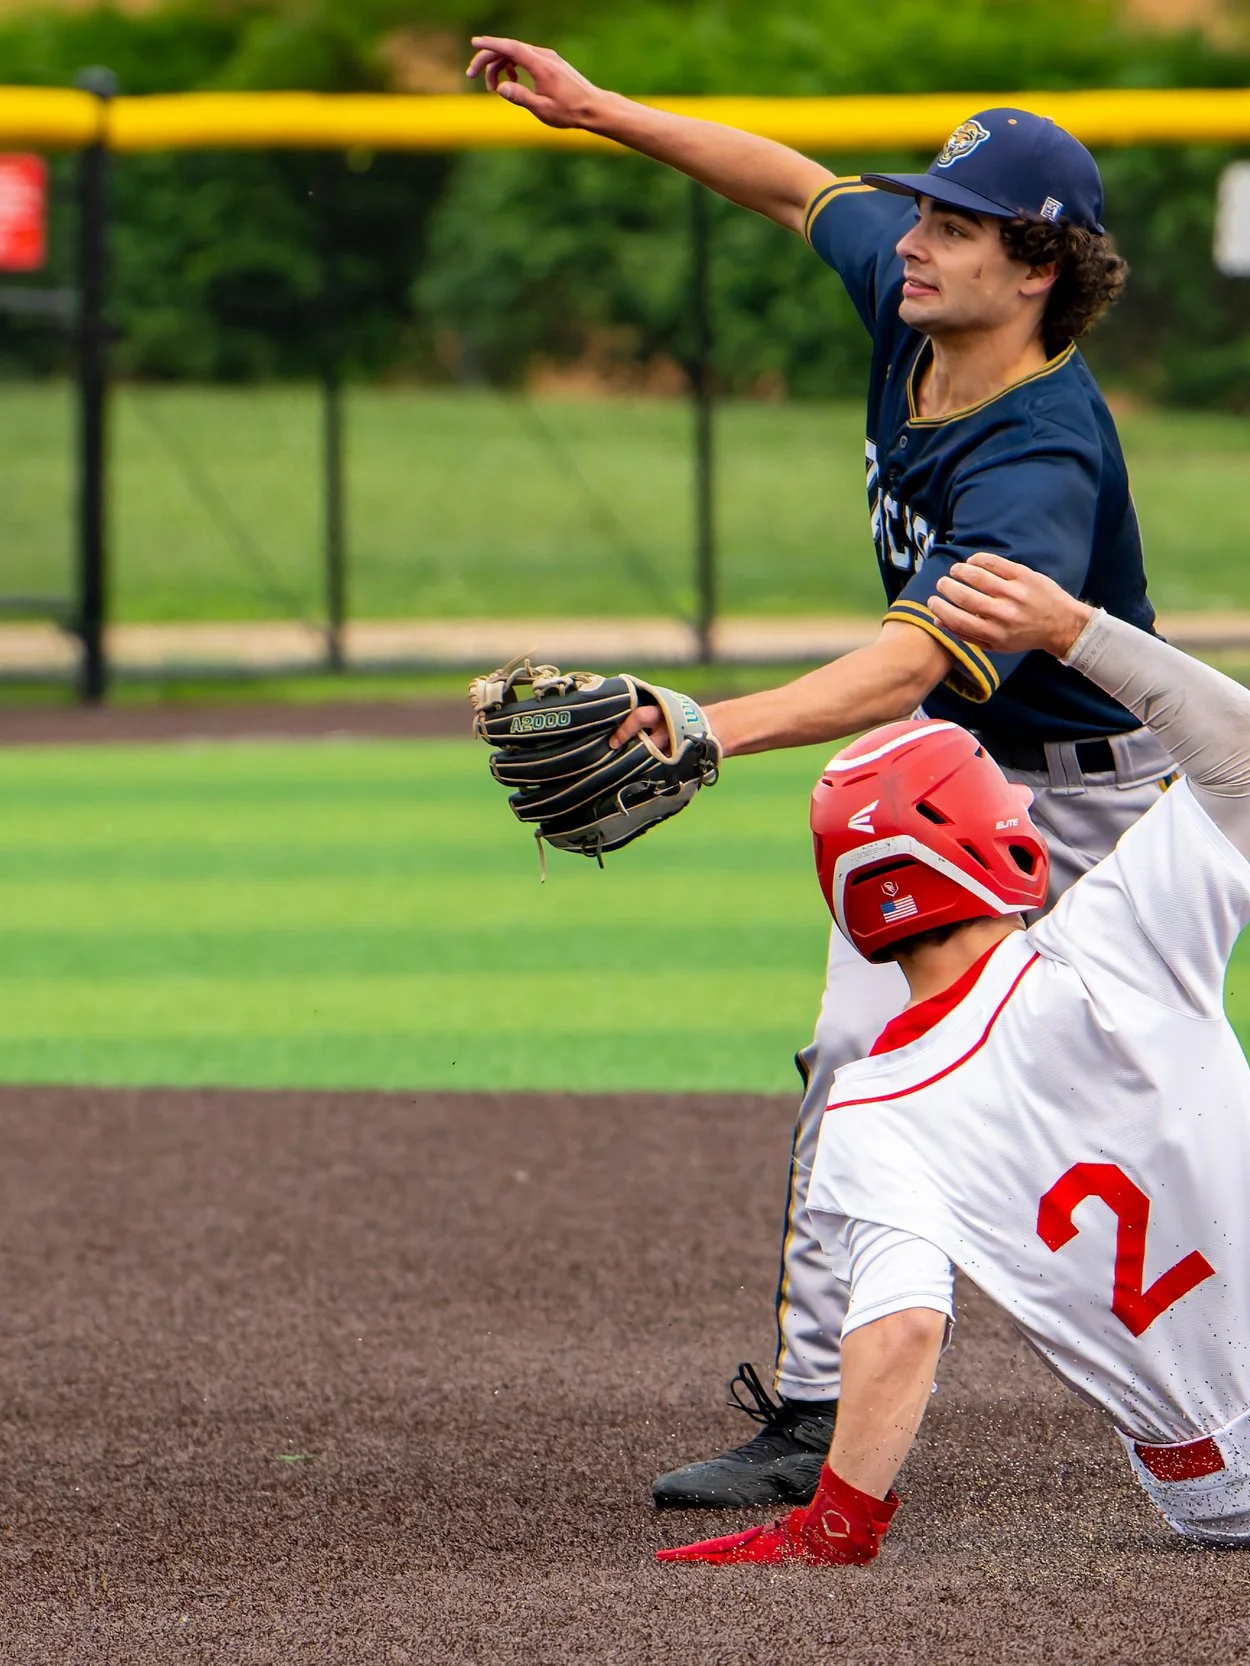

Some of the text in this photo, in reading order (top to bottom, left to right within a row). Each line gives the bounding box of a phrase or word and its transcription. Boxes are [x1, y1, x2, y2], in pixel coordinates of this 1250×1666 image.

[510, 710, 571, 734] A2000
[995, 818, 1019, 831] ELITE
[1036, 1161, 1217, 1339] 2
